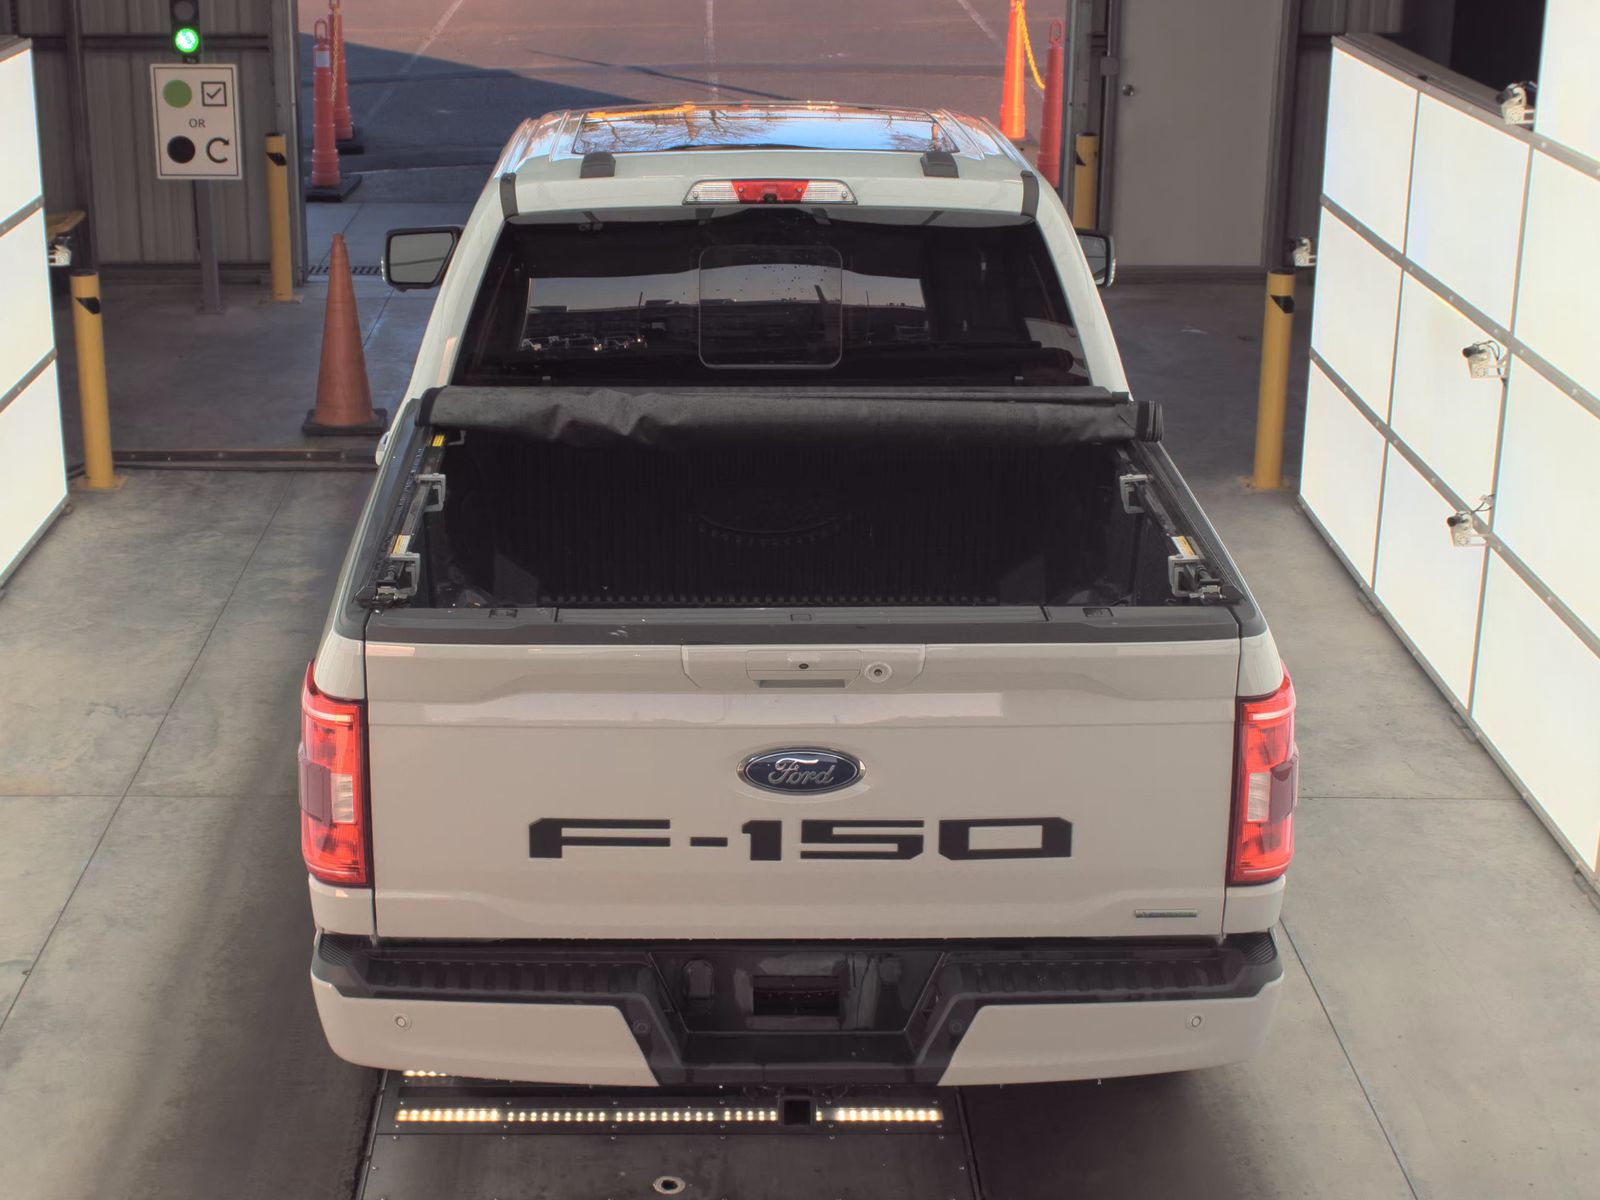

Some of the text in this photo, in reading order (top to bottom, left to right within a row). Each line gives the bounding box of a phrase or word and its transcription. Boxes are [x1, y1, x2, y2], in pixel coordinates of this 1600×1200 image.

[188, 118, 206, 129] OR
[767, 757, 836, 785] Ford
[528, 816, 1073, 861] F-150
